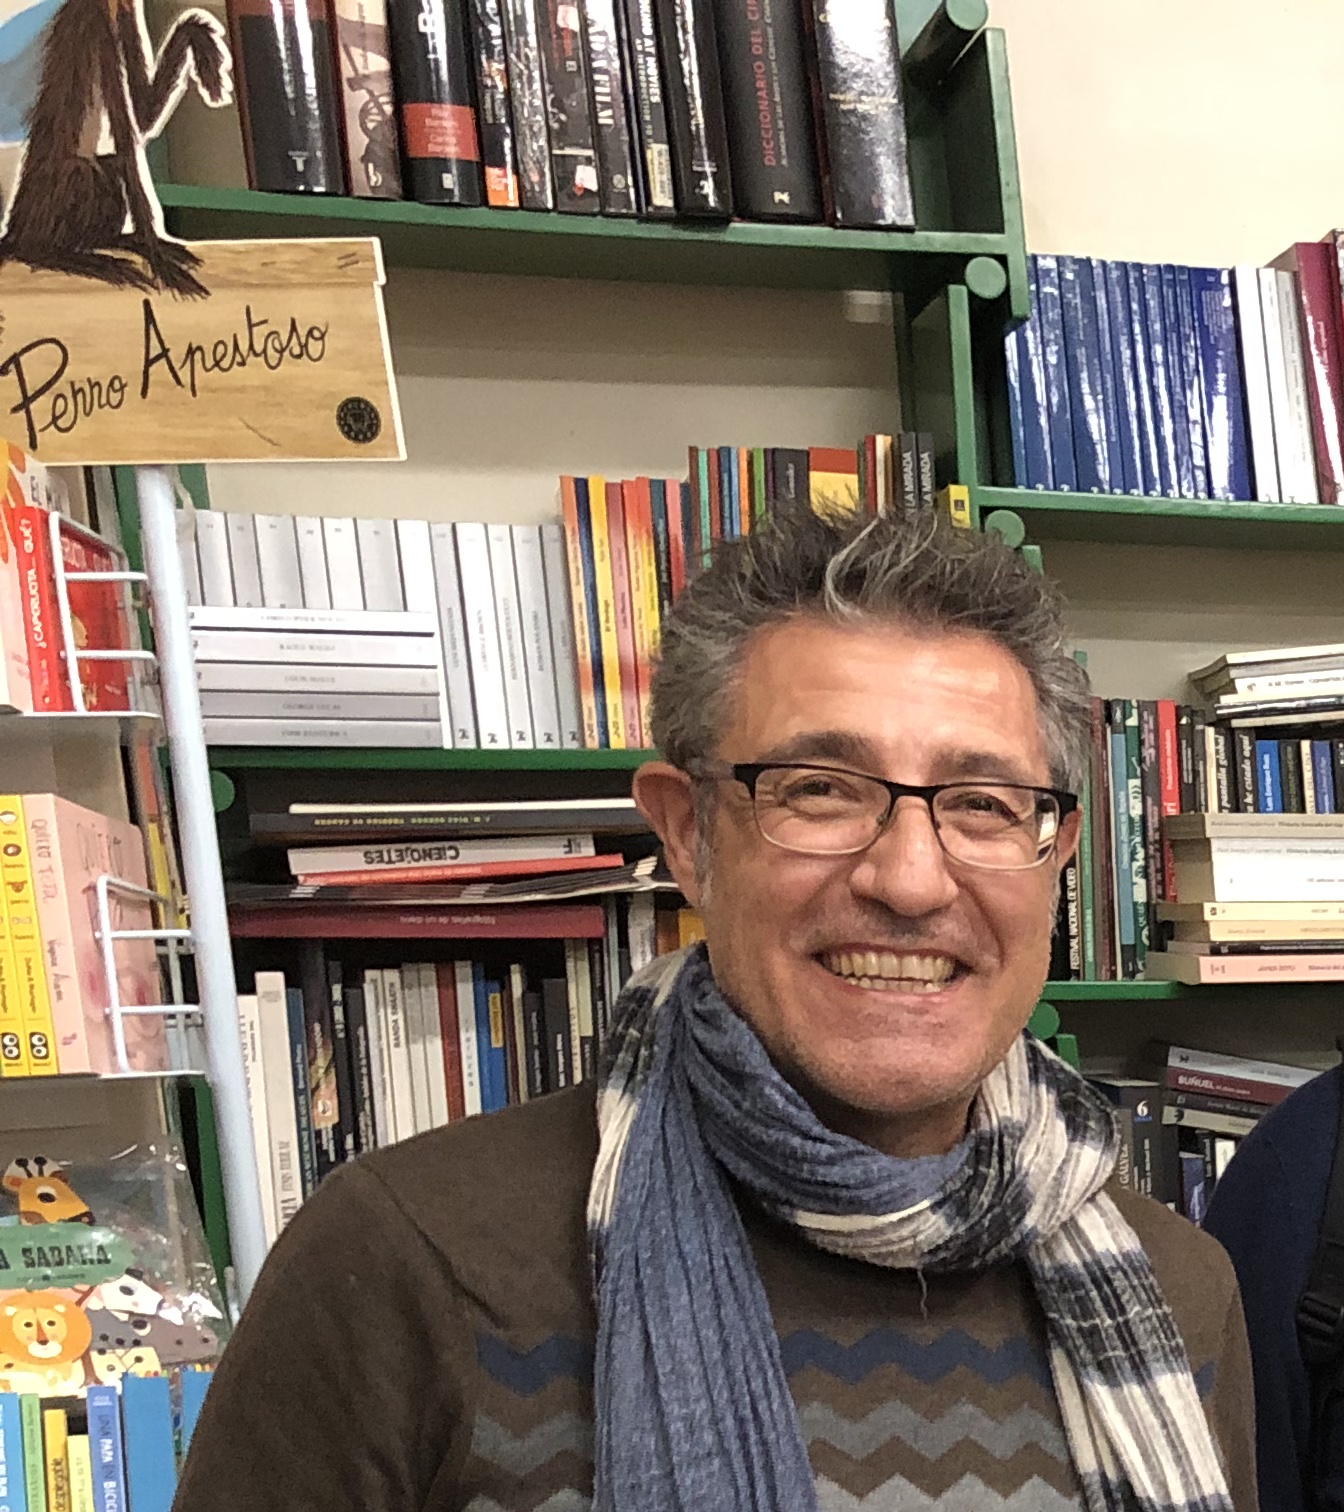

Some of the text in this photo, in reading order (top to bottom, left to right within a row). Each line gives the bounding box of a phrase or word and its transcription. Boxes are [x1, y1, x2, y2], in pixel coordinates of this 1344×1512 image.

[749, 29, 777, 167] DICCIONARIO DEL
[0, 298, 329, 452] Perro Apestoso
[1136, 1101, 1149, 1117] 6
[22, 1243, 113, 1270] SABANA
[99, 1437, 114, 1463] PAPA
